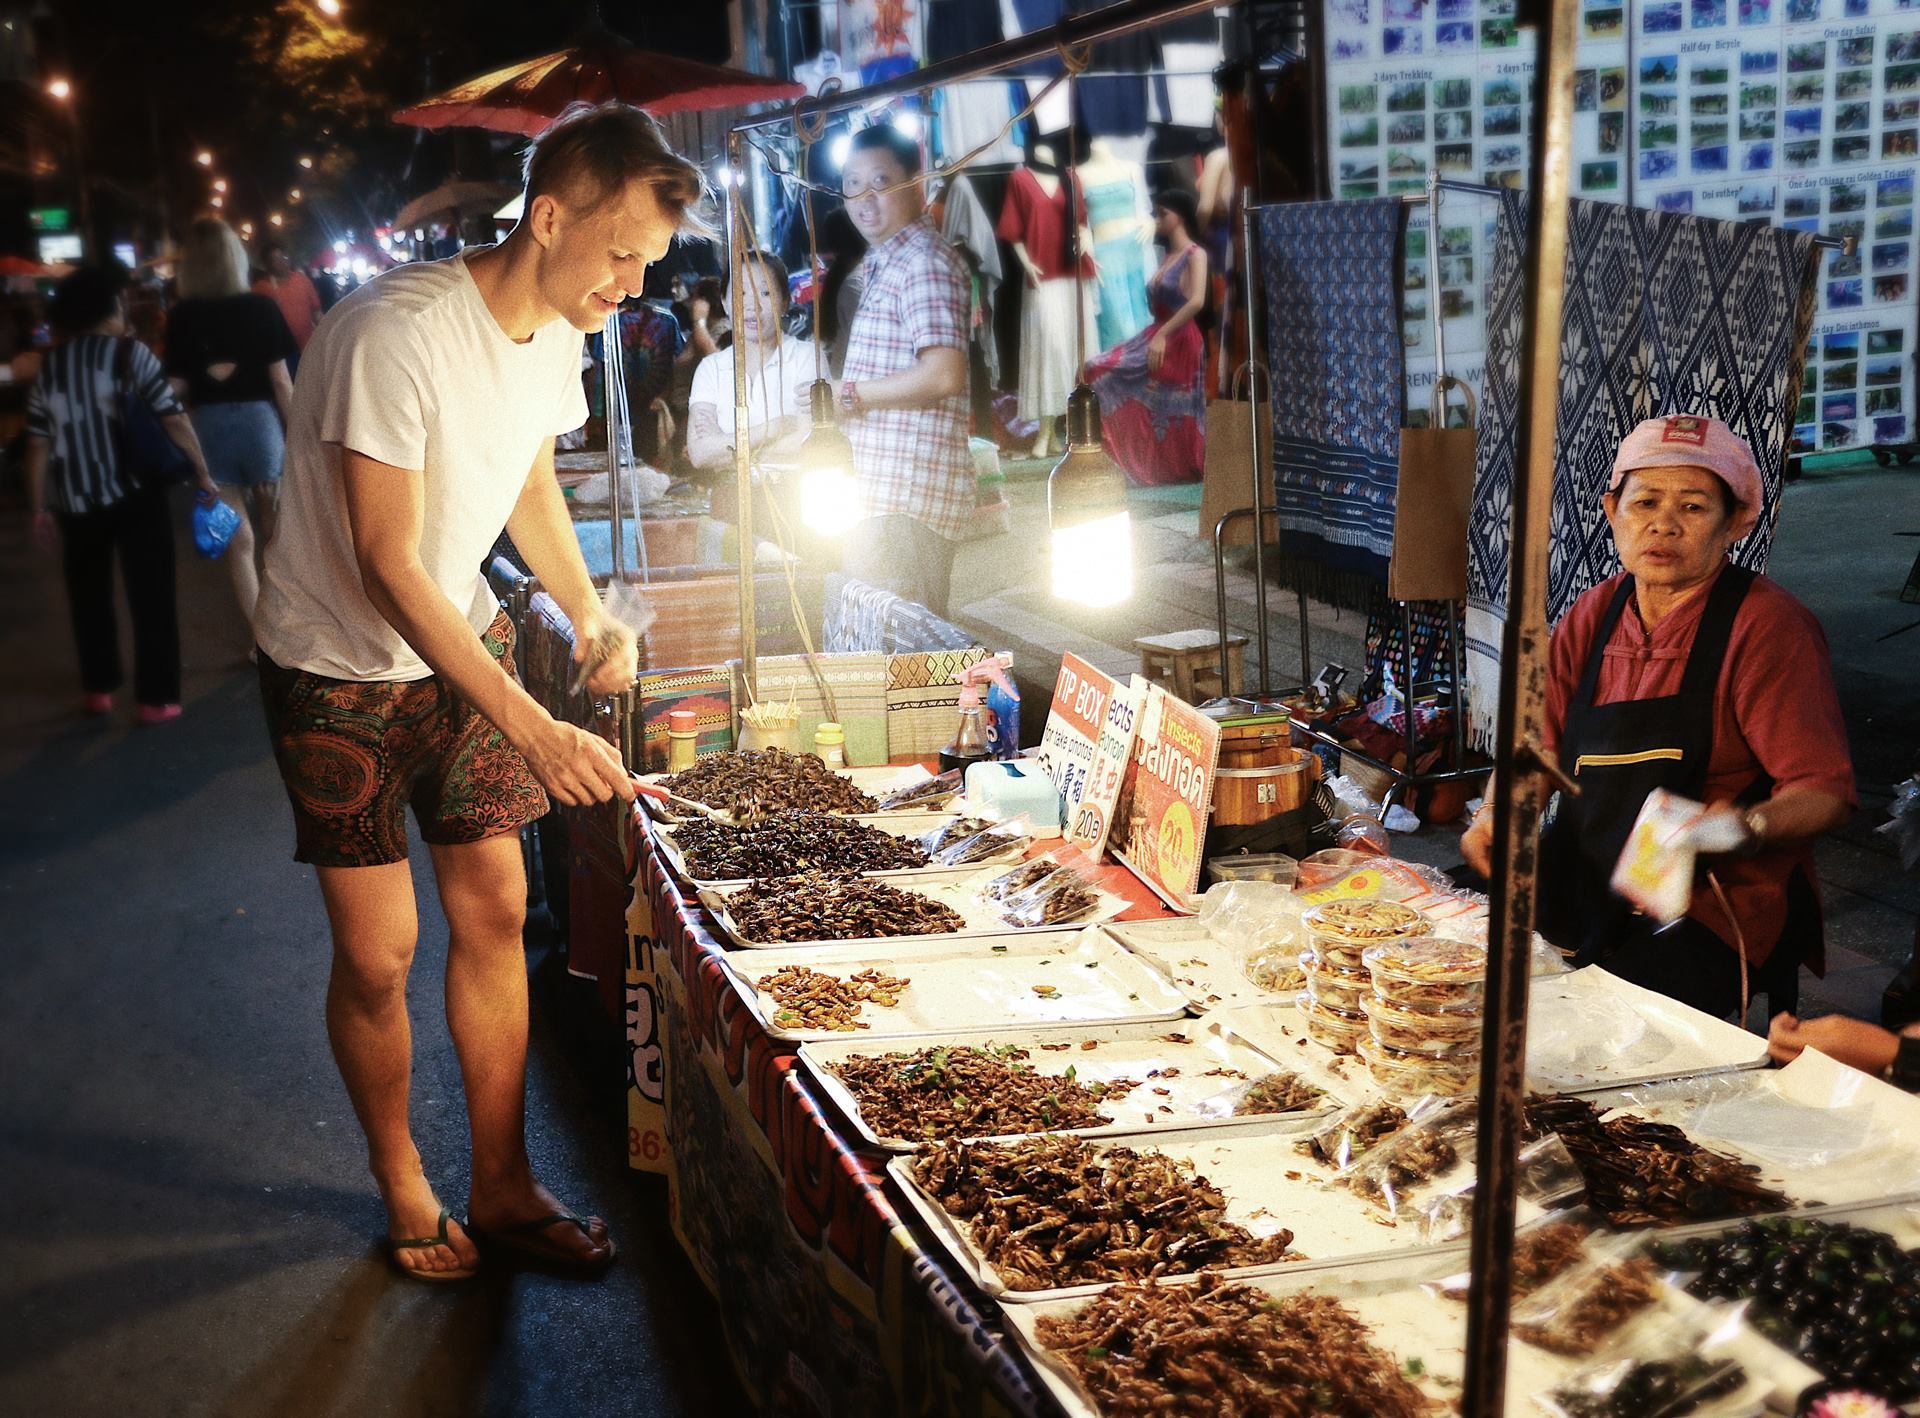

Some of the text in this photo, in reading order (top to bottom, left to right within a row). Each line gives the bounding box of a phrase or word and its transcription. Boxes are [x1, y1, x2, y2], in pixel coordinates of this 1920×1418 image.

[1840, 26, 1853, 39] day
[1680, 38, 1741, 53] Half day Bicycle
[1380, 71, 1398, 84] days
[1399, 69, 1433, 82] Trekking
[1503, 63, 1520, 76] days
[1804, 178, 1817, 189] day
[1819, 175, 1844, 187] Chiang
[1857, 171, 1882, 183] Golden
[1057, 665, 1106, 728] TIP BOX
[1054, 729, 1069, 750] take
[1067, 736, 1093, 761] photos
[1166, 719, 1202, 757] insects
